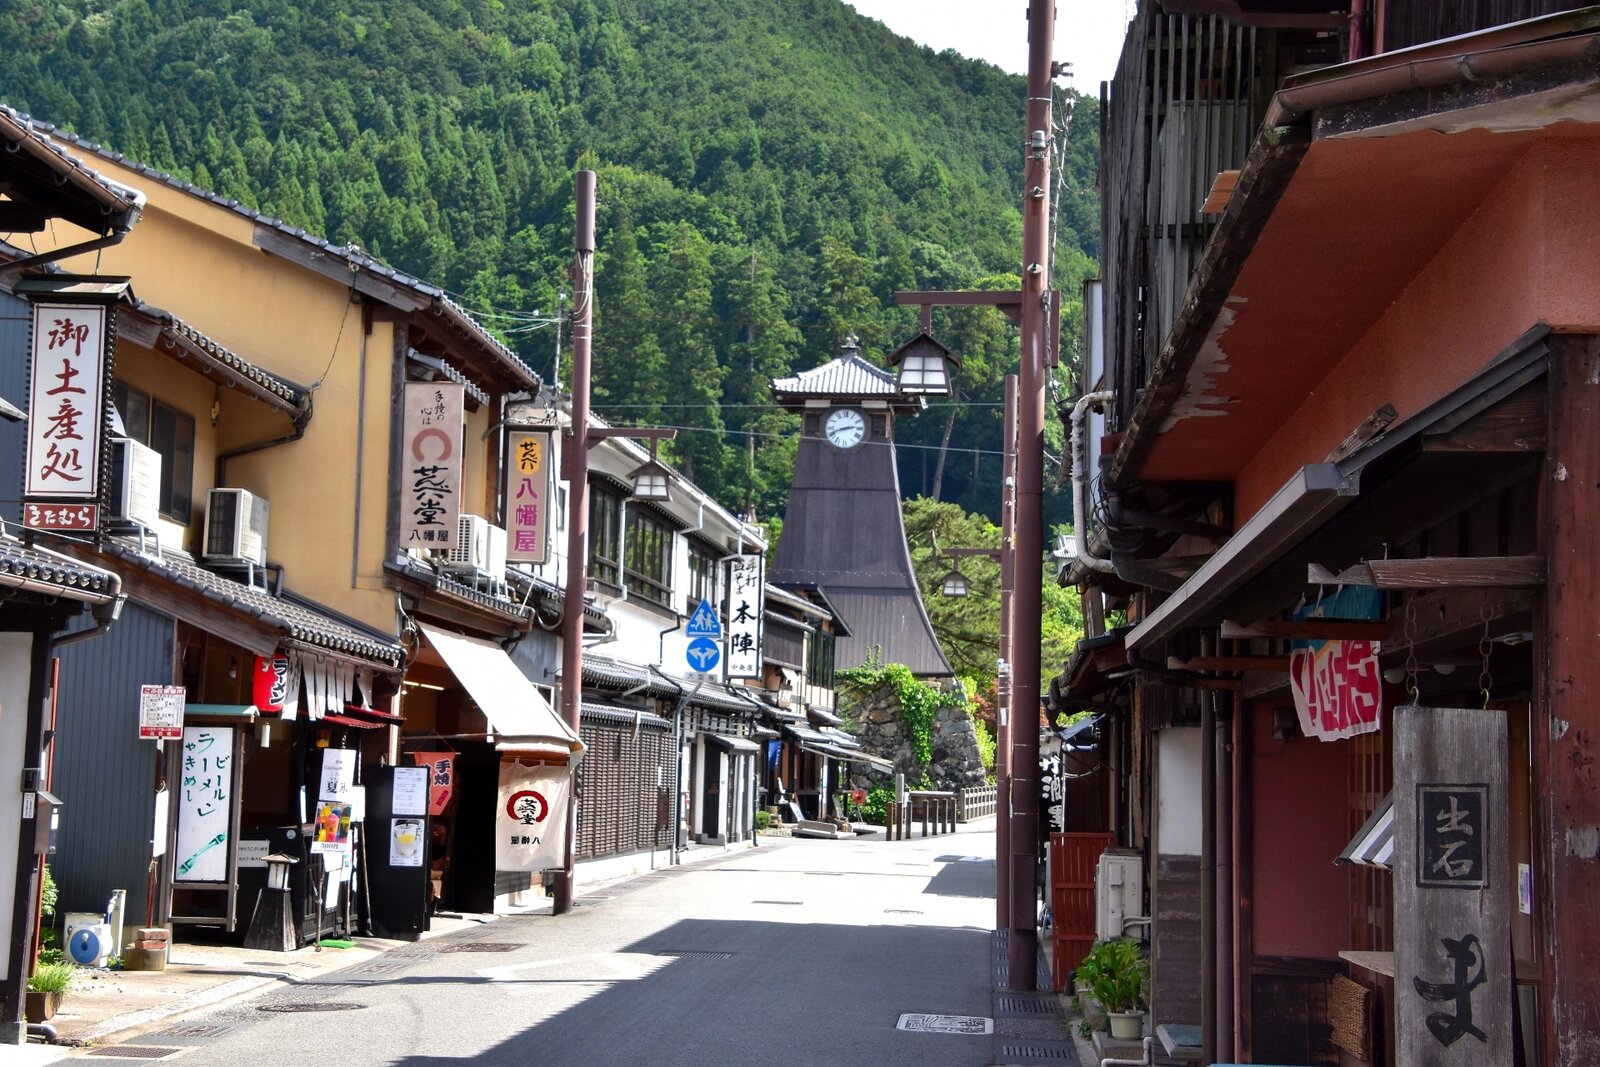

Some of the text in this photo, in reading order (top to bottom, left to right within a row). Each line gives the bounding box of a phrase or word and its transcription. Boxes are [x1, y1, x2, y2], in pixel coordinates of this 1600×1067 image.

[41, 318, 90, 482] 御土産処
[420, 407, 433, 425] 心は
[434, 390, 446, 421] 手焼の
[28, 505, 91, 528] きたむら
[409, 529, 449, 542] 八幡屋
[514, 477, 538, 552] 八幡屋
[731, 600, 757, 657] 本陣
[270, 659, 287, 705] ラーメン
[731, 663, 753, 672] 中央店
[184, 741, 196, 802] やきめし
[197, 733, 216, 817] ラーメン
[214, 756, 230, 801] ビール
[434, 759, 451, 786] 手焼
[1432, 796, 1474, 878] 出石
